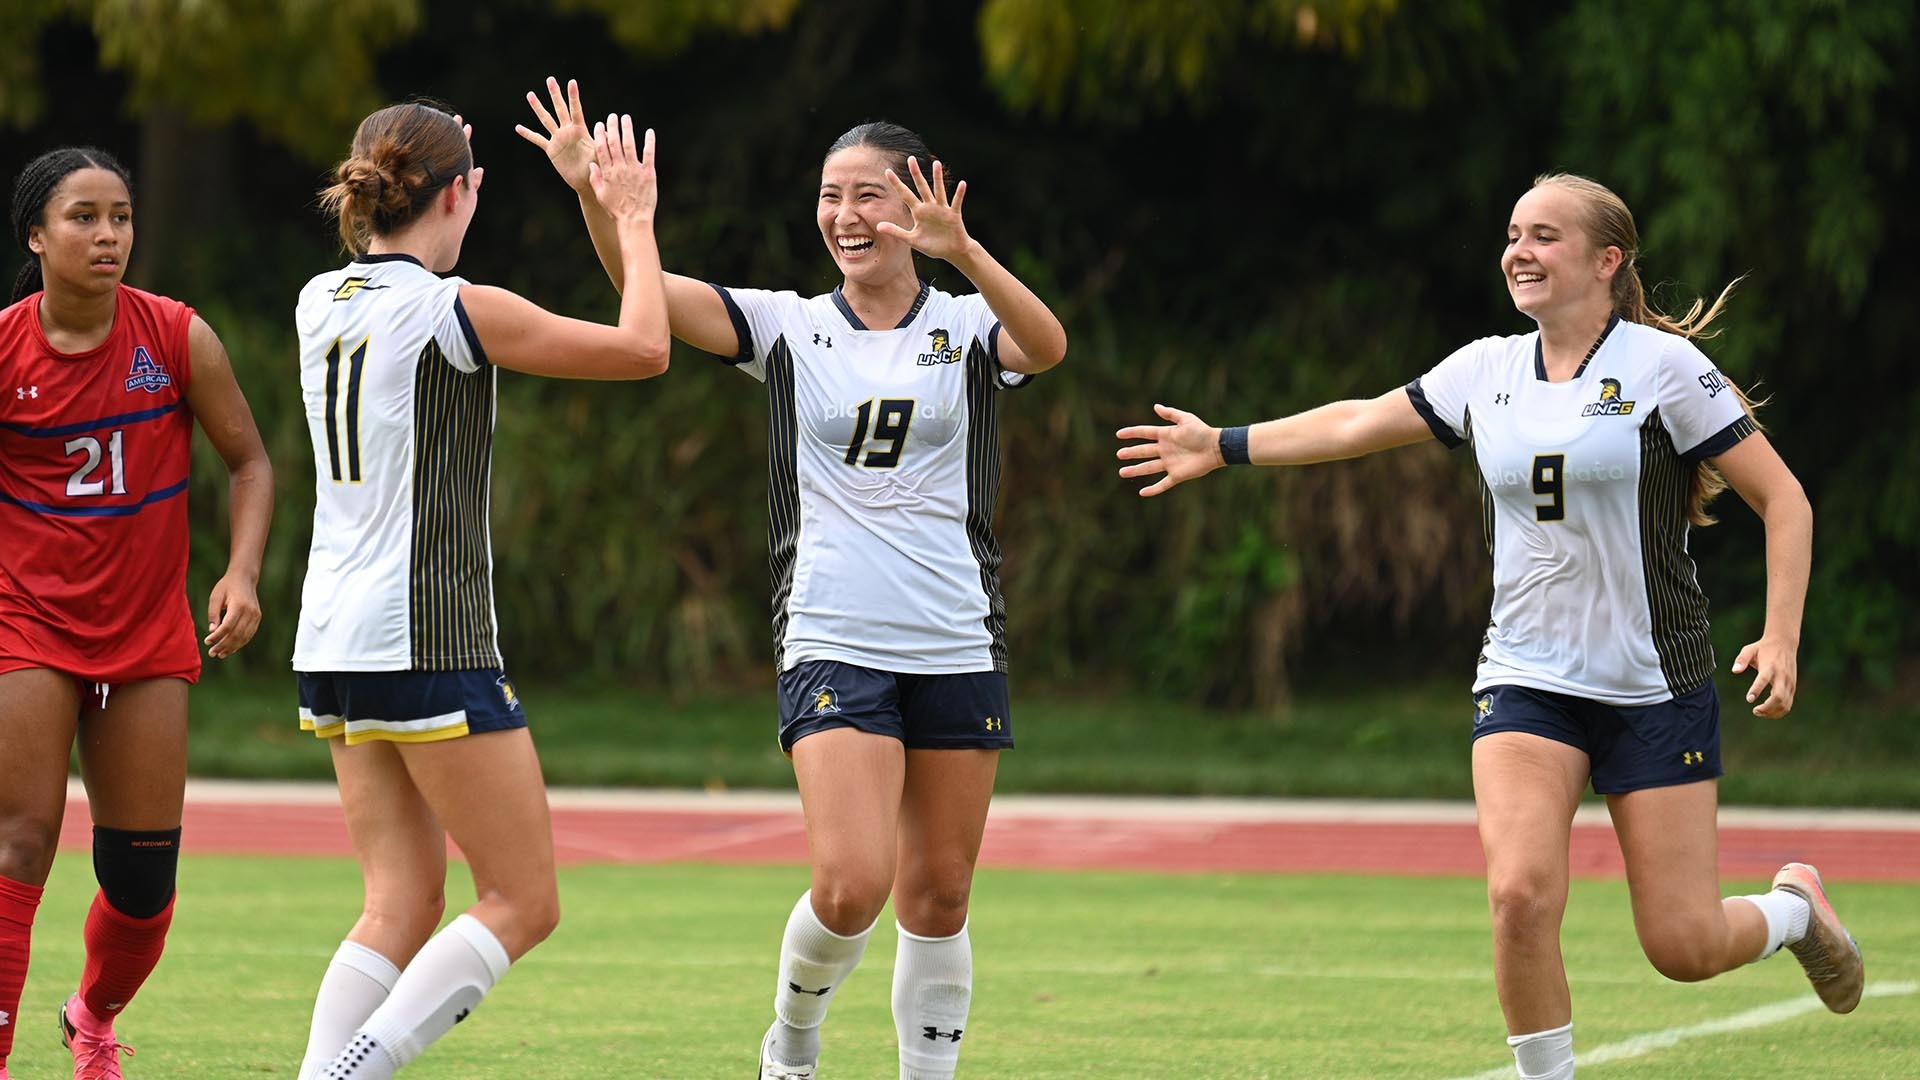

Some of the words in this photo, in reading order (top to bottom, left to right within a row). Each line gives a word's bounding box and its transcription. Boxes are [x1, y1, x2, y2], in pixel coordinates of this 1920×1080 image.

[917, 346, 962, 366] UNCG
[324, 334, 370, 484] 11
[843, 397, 916, 469] 19
[1581, 401, 1635, 417] UNCG
[64, 430, 127, 496] 21
[1531, 453, 1566, 523] 9
